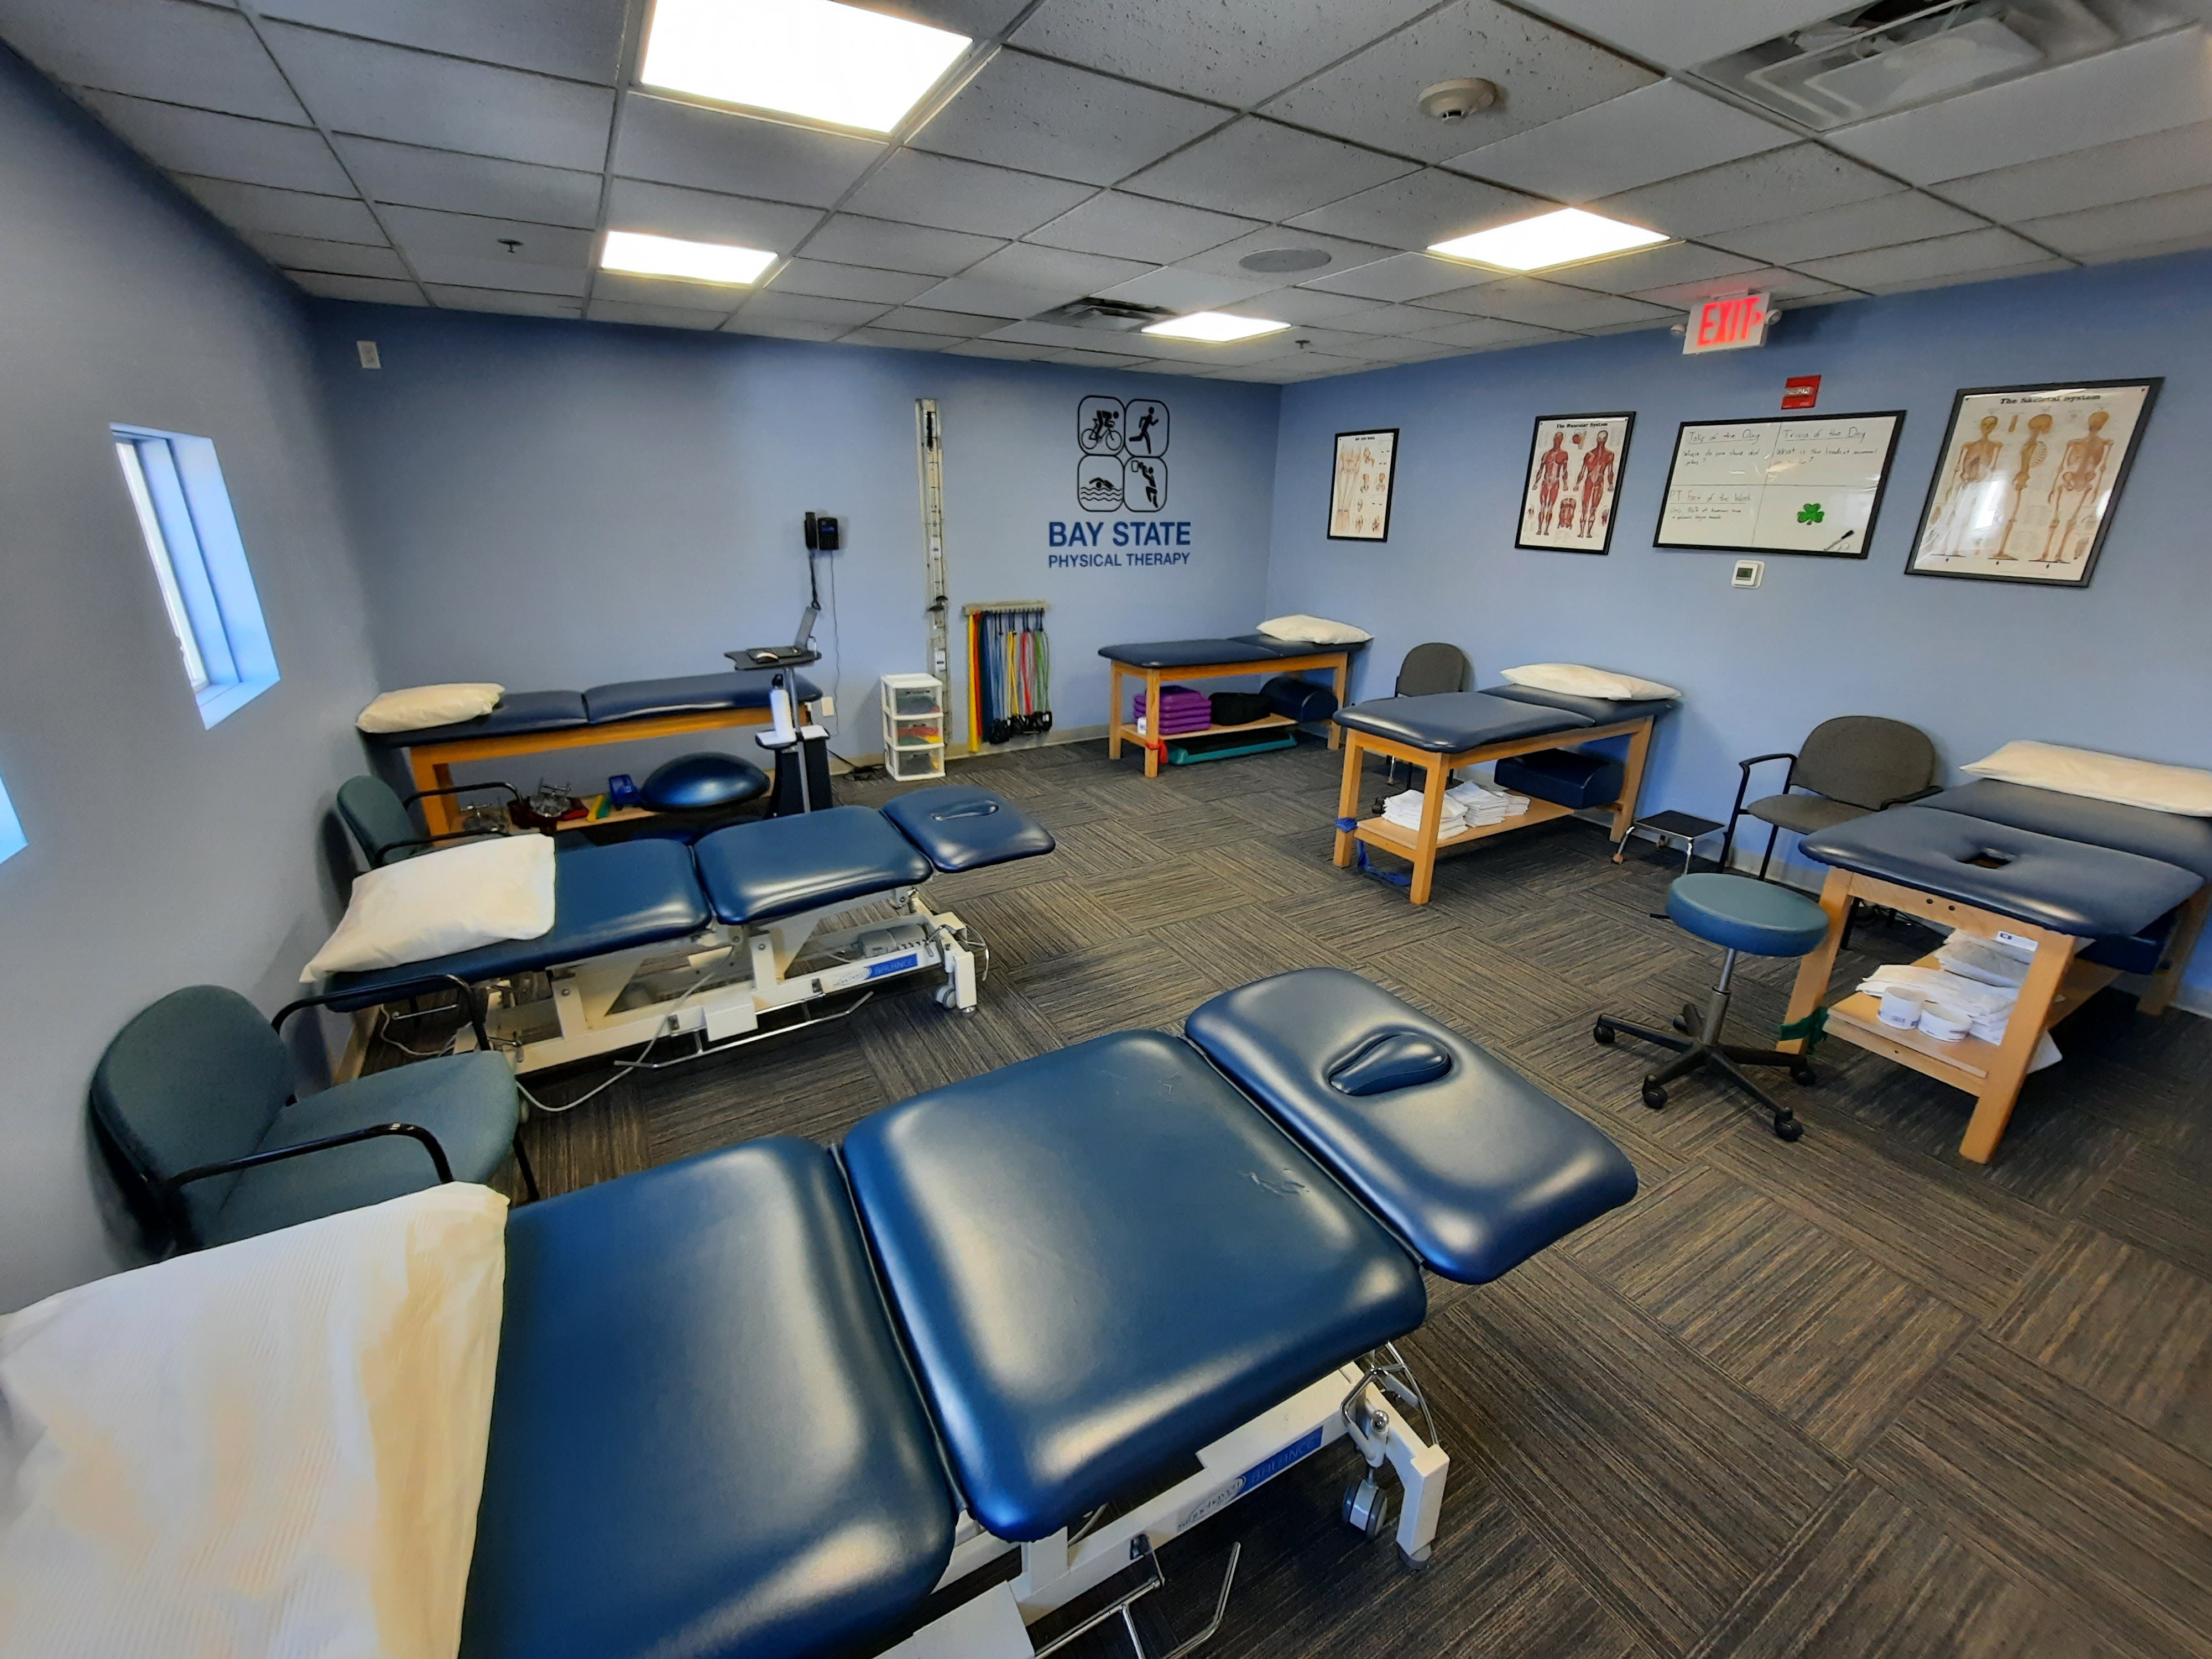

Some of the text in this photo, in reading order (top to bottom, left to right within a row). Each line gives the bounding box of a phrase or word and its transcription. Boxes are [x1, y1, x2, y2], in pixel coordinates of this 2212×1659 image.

[1697, 296, 1760, 346] EXIT
[1742, 429, 1760, 445] Day
[1848, 426, 1866, 444] Day
[1670, 489, 1682, 501] PT
[1049, 521, 1191, 546] BAY STATE
[1048, 552, 1191, 568] PHYSICAL THERAPY
[1251, 1439, 1316, 1483] BALANCE
